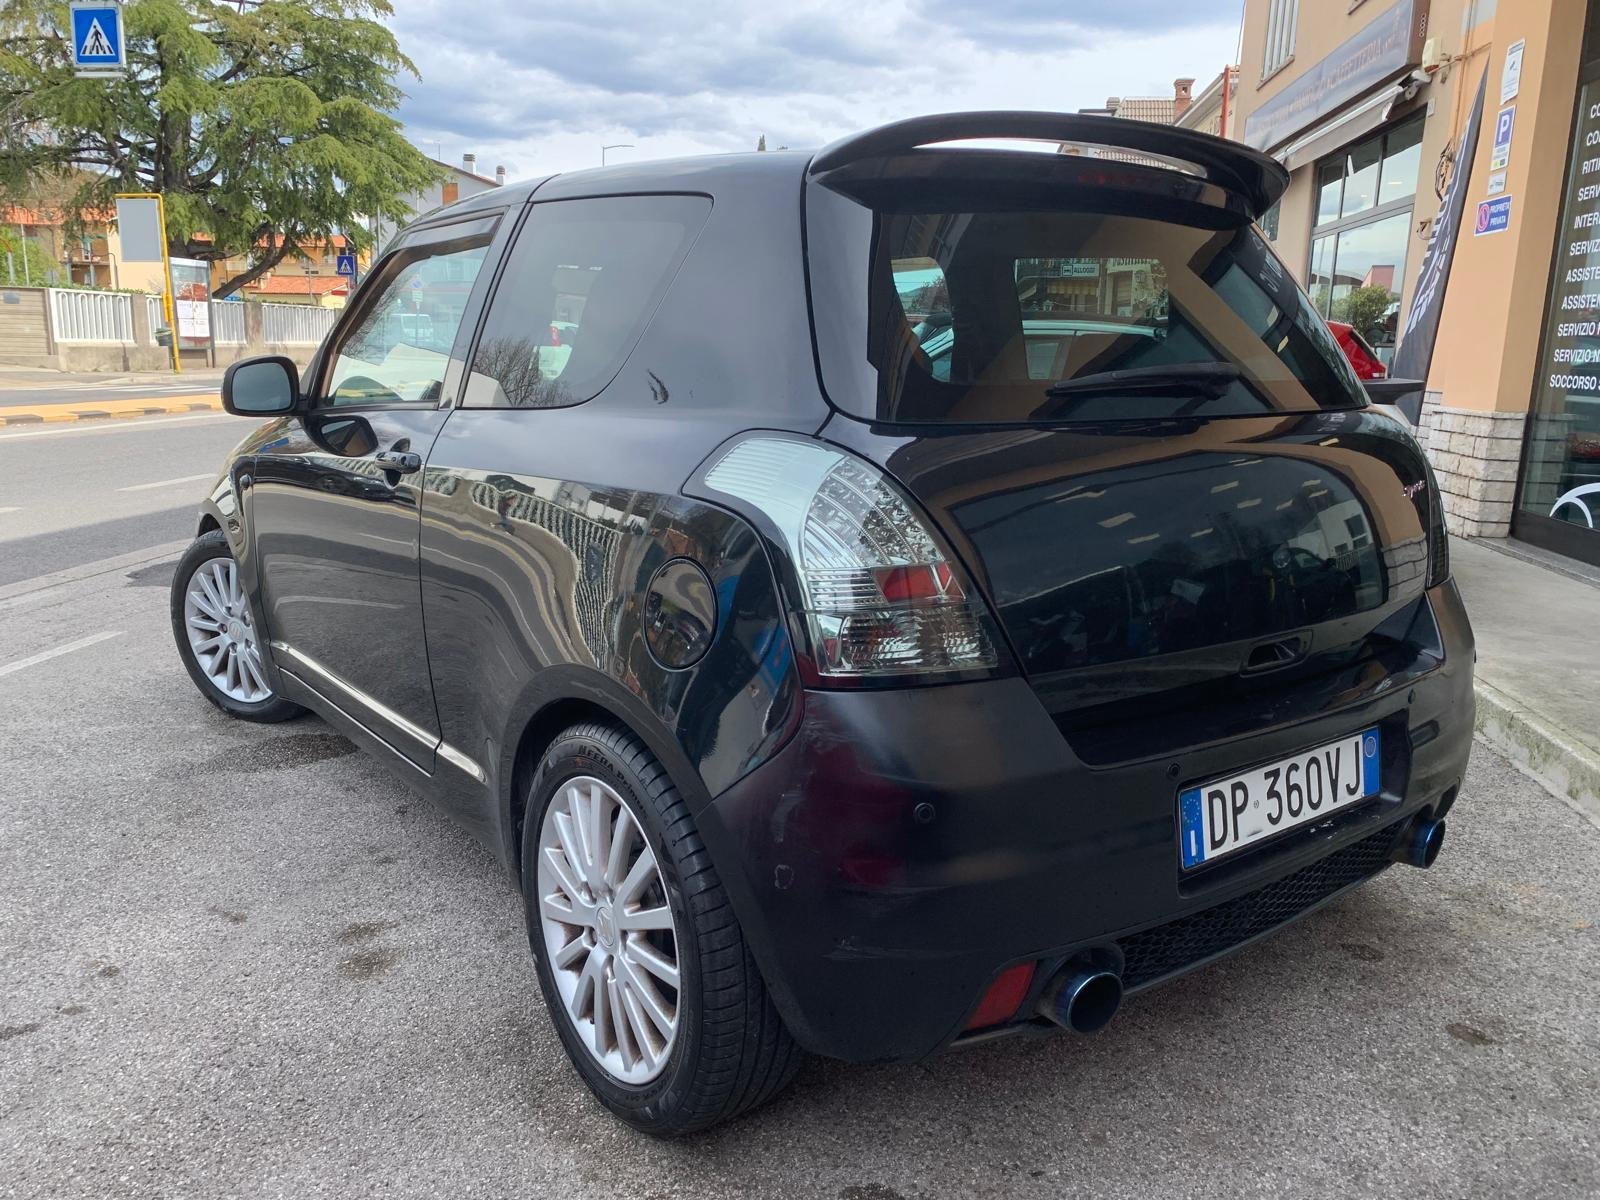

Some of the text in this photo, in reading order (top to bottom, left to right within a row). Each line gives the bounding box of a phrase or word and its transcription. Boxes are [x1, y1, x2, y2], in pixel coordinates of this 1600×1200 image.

[1498, 114, 1510, 142] P
[1574, 211, 1600, 230] INTER
[1557, 322, 1596, 337] SERVIZIO
[1553, 348, 1591, 363] SERVIZIO
[1550, 374, 1597, 391] SOCCORSO
[1207, 780, 1249, 851] DP
[1264, 741, 1361, 826] 360VJ
